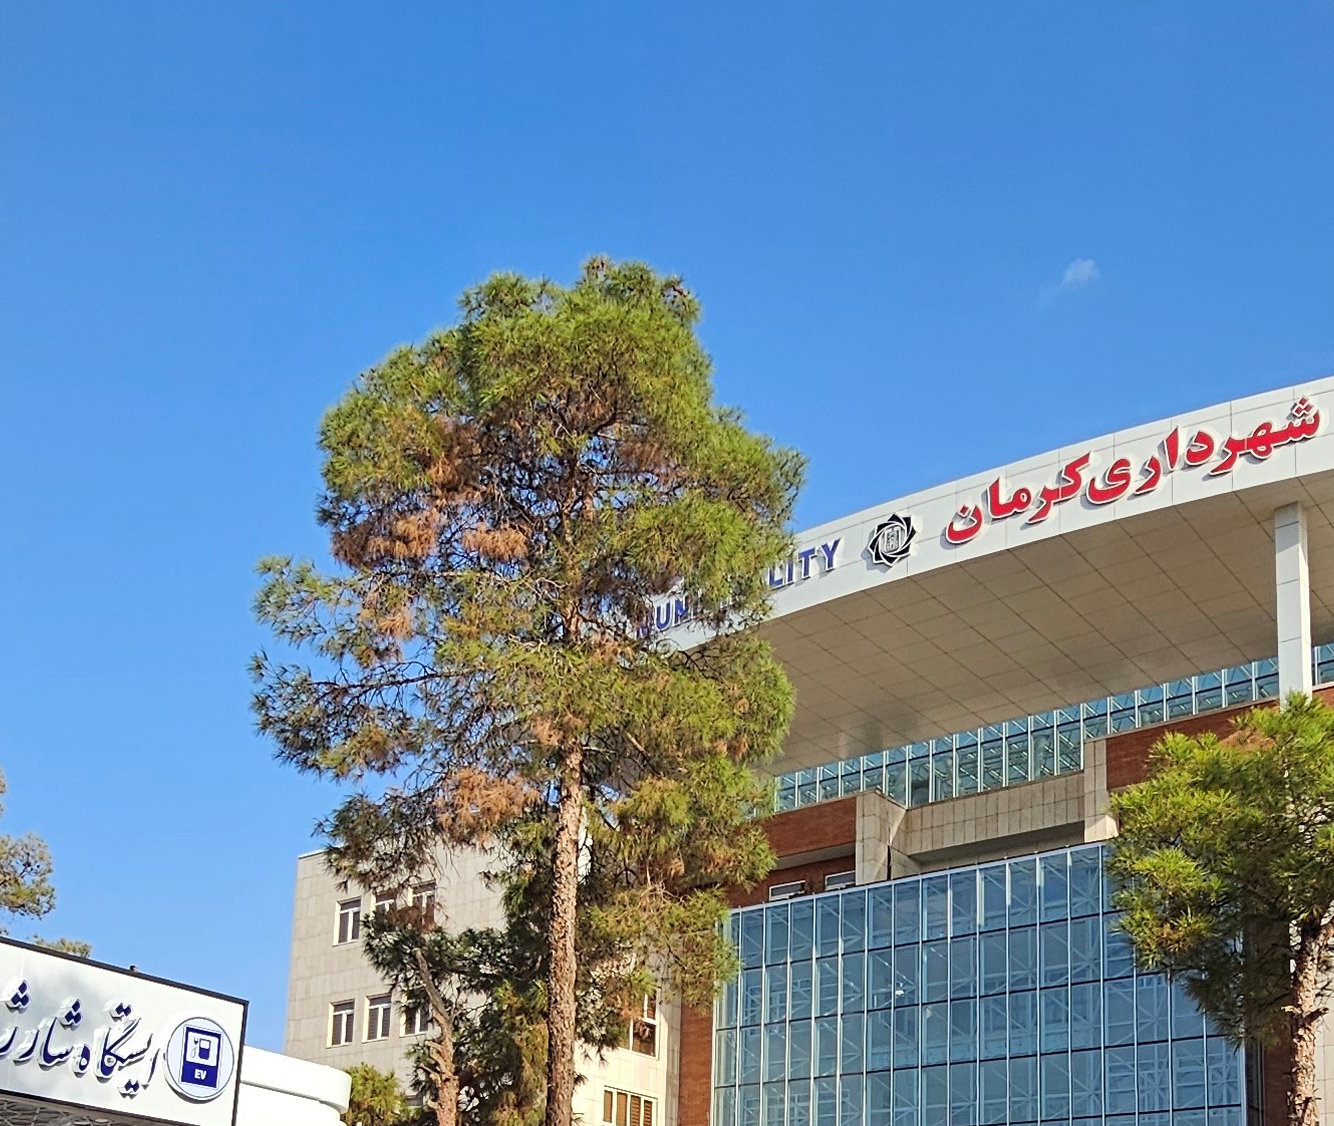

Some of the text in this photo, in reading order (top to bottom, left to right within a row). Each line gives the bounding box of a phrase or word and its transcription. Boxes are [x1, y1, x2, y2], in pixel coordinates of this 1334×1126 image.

[945, 395, 1322, 544] شهرداری کرمان
[73, 1000, 160, 1098] ایستگاه
[193, 1068, 207, 1080] EV
